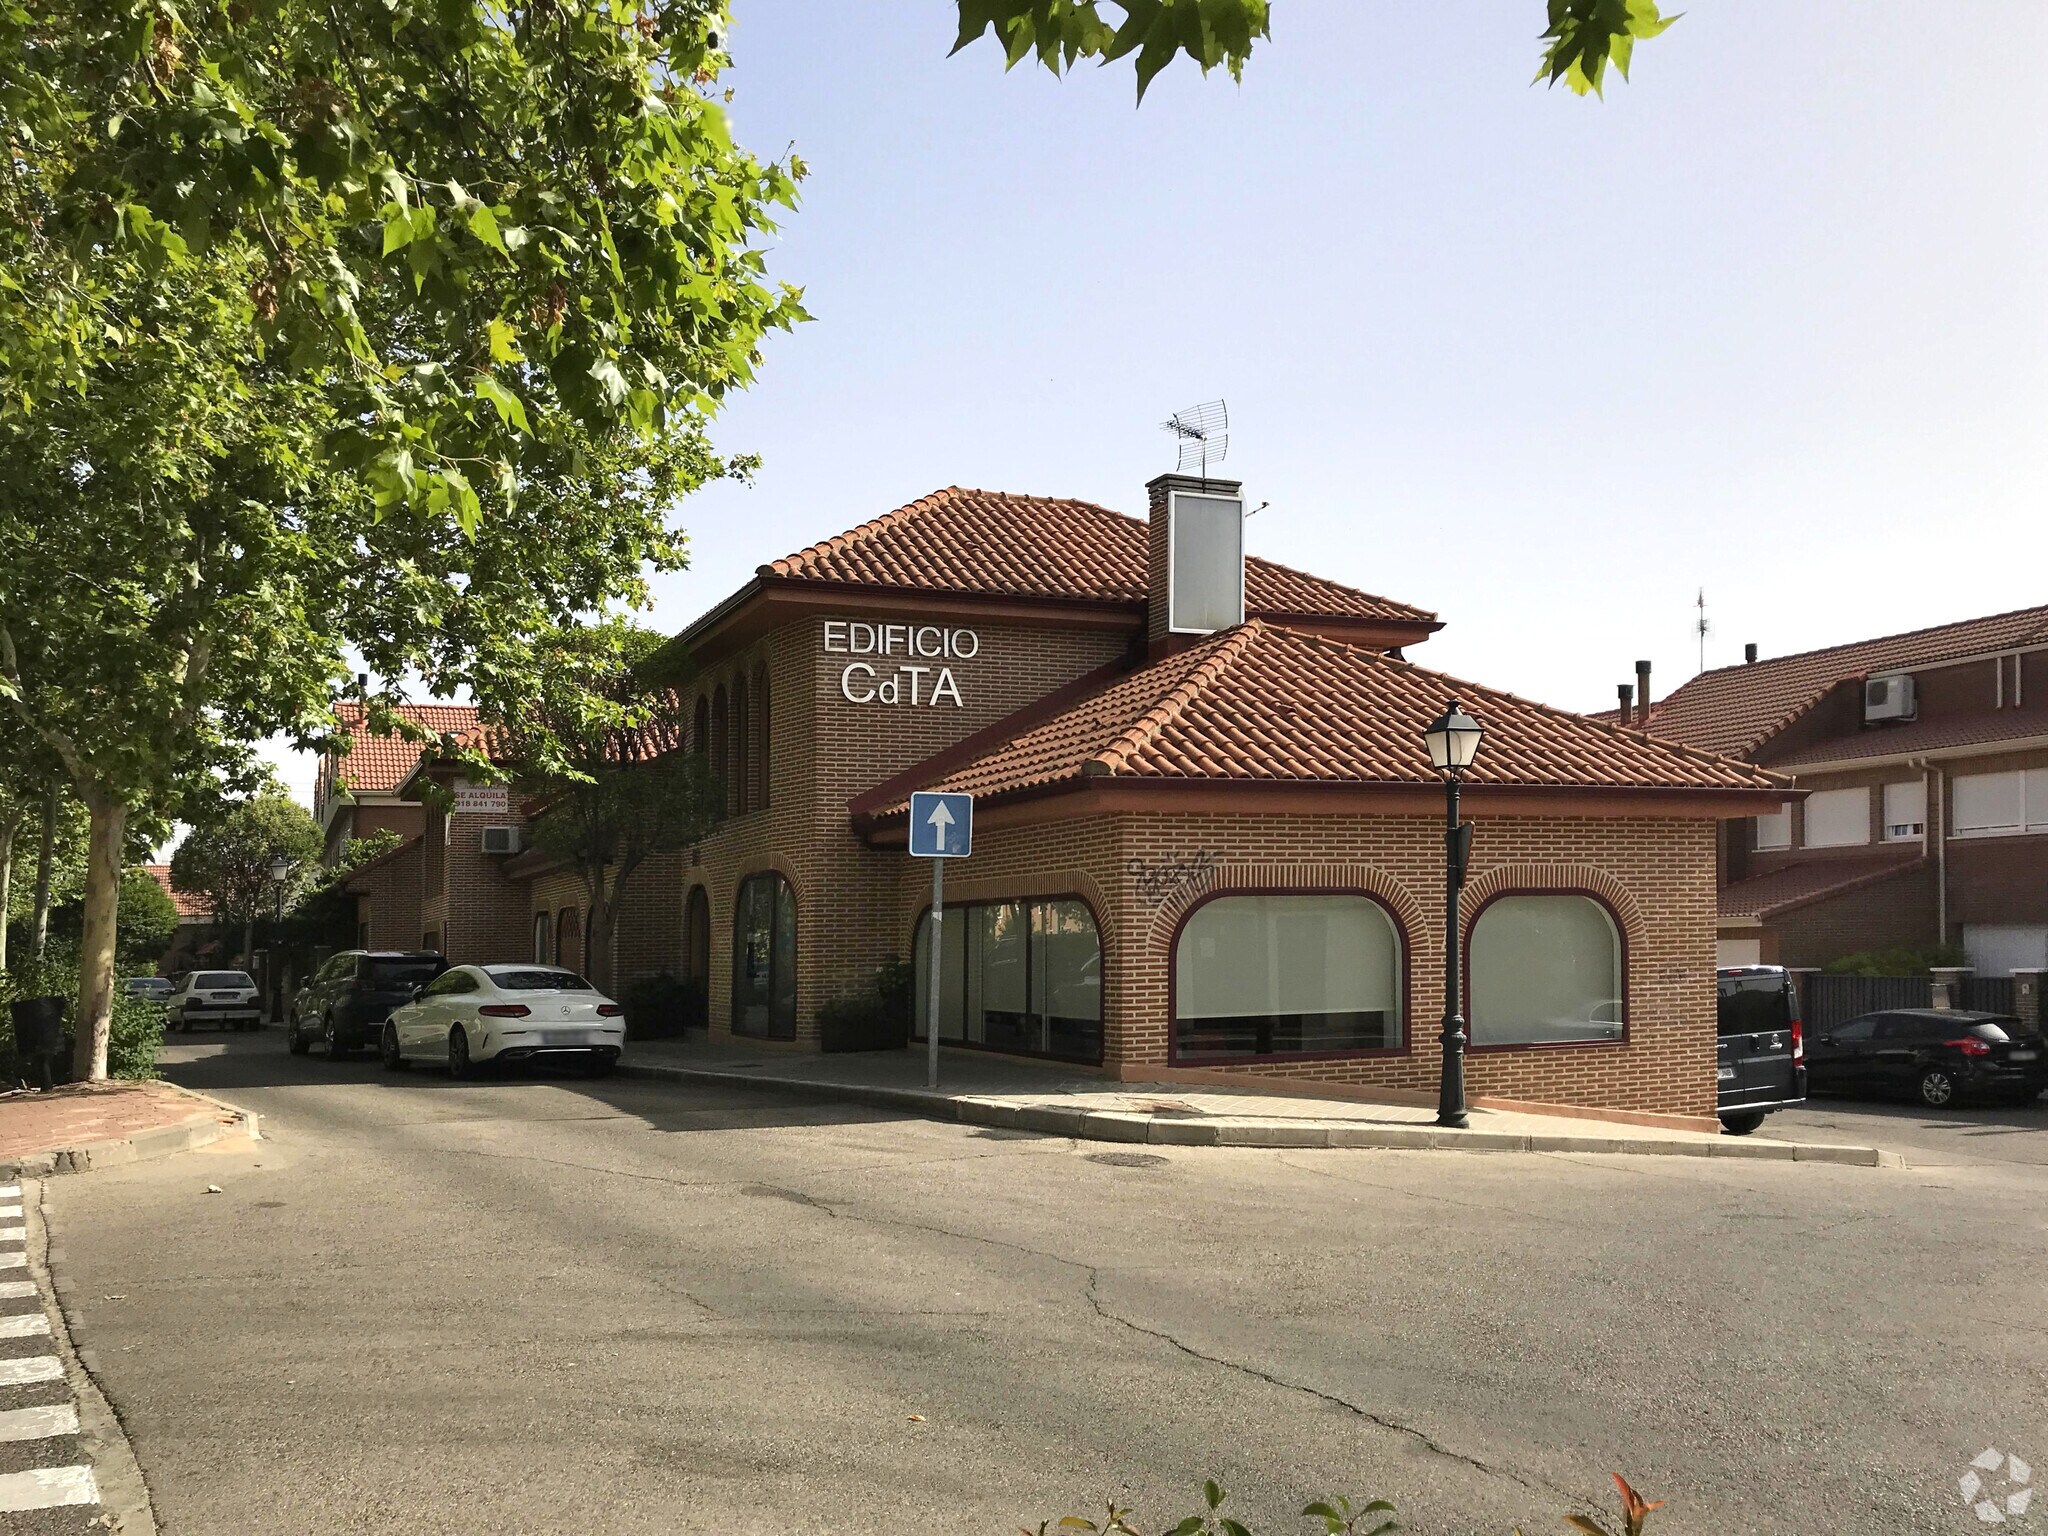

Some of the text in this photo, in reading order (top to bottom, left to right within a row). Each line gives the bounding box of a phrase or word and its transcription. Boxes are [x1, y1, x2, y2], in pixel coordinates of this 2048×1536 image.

[824, 621, 979, 659] EDIFICIO
[841, 662, 964, 707] CdTA
[455, 791, 466, 799] SE
